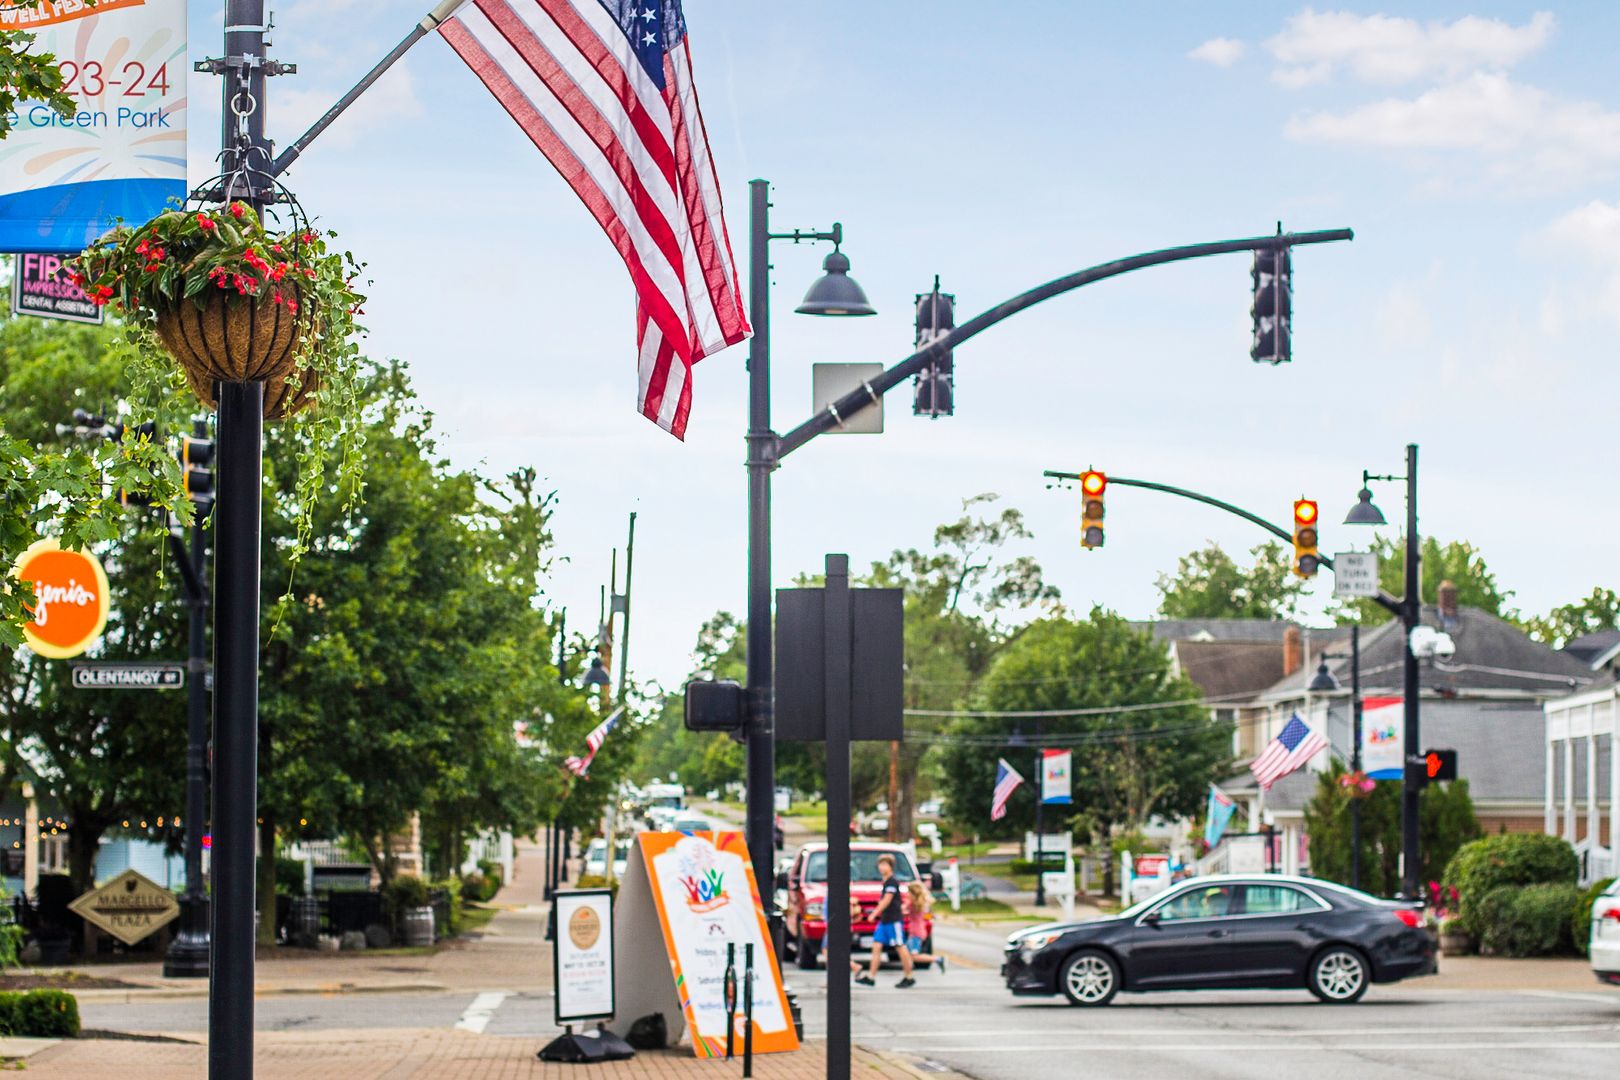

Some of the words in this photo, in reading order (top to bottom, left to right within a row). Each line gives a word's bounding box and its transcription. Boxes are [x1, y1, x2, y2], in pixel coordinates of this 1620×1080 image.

[58, 61, 170, 97] 23-24
[29, 106, 107, 127] Green
[118, 107, 171, 128] Park
[23, 294, 53, 311] DENTAL
[80, 669, 160, 684] OLENTANGY
[97, 895, 169, 906] MARCELLO
[110, 914, 151, 927] PLAZA
